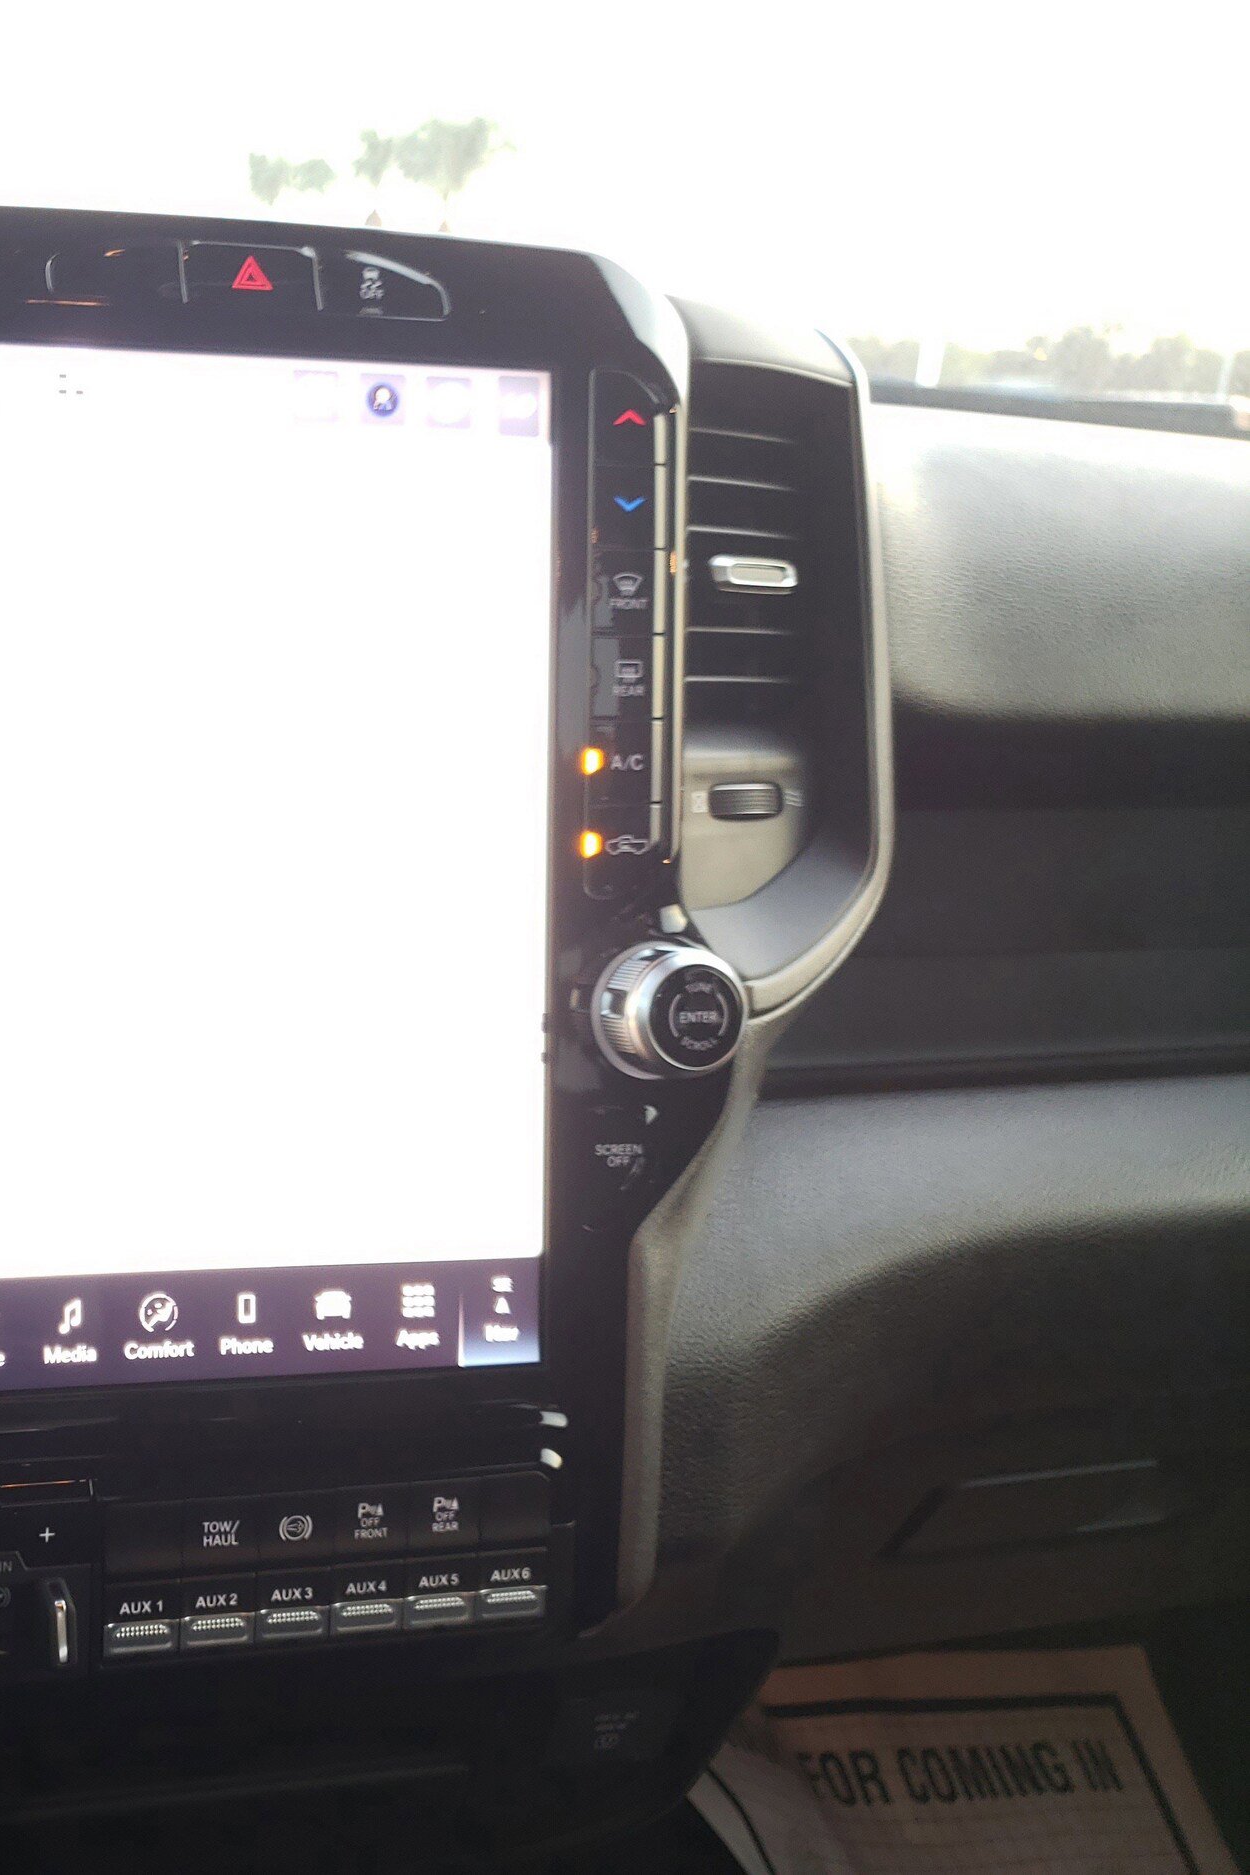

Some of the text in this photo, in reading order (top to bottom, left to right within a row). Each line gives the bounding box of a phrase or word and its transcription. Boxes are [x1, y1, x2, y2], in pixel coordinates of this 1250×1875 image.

[610, 754, 644, 771] A/C
[679, 1010, 722, 1024] ENTER
[594, 1142, 643, 1156] SCREEN
[606, 1155, 630, 1168] OFF
[219, 1336, 274, 1357] Phone
[302, 1330, 365, 1353] Vehicle
[395, 1327, 441, 1351] Apps
[43, 1343, 97, 1365] Media
[124, 1338, 195, 1361] Comfort
[360, 1517, 381, 1528] OFF
[434, 1510, 456, 1522] OFF
[202, 1520, 241, 1535] TOW/
[354, 1527, 389, 1540] FRONT
[432, 1520, 460, 1533] REAR
[202, 1533, 240, 1547] HAUL
[418, 1573, 460, 1589] AUX 5
[490, 1566, 531, 1582] AUX 6
[271, 1587, 314, 1602] AUX 3
[345, 1580, 388, 1596] AUX 4
[119, 1600, 164, 1615] AUX 1
[195, 1593, 238, 1609] AUX 2
[795, 1739, 1127, 1808] FOR COMING IN
